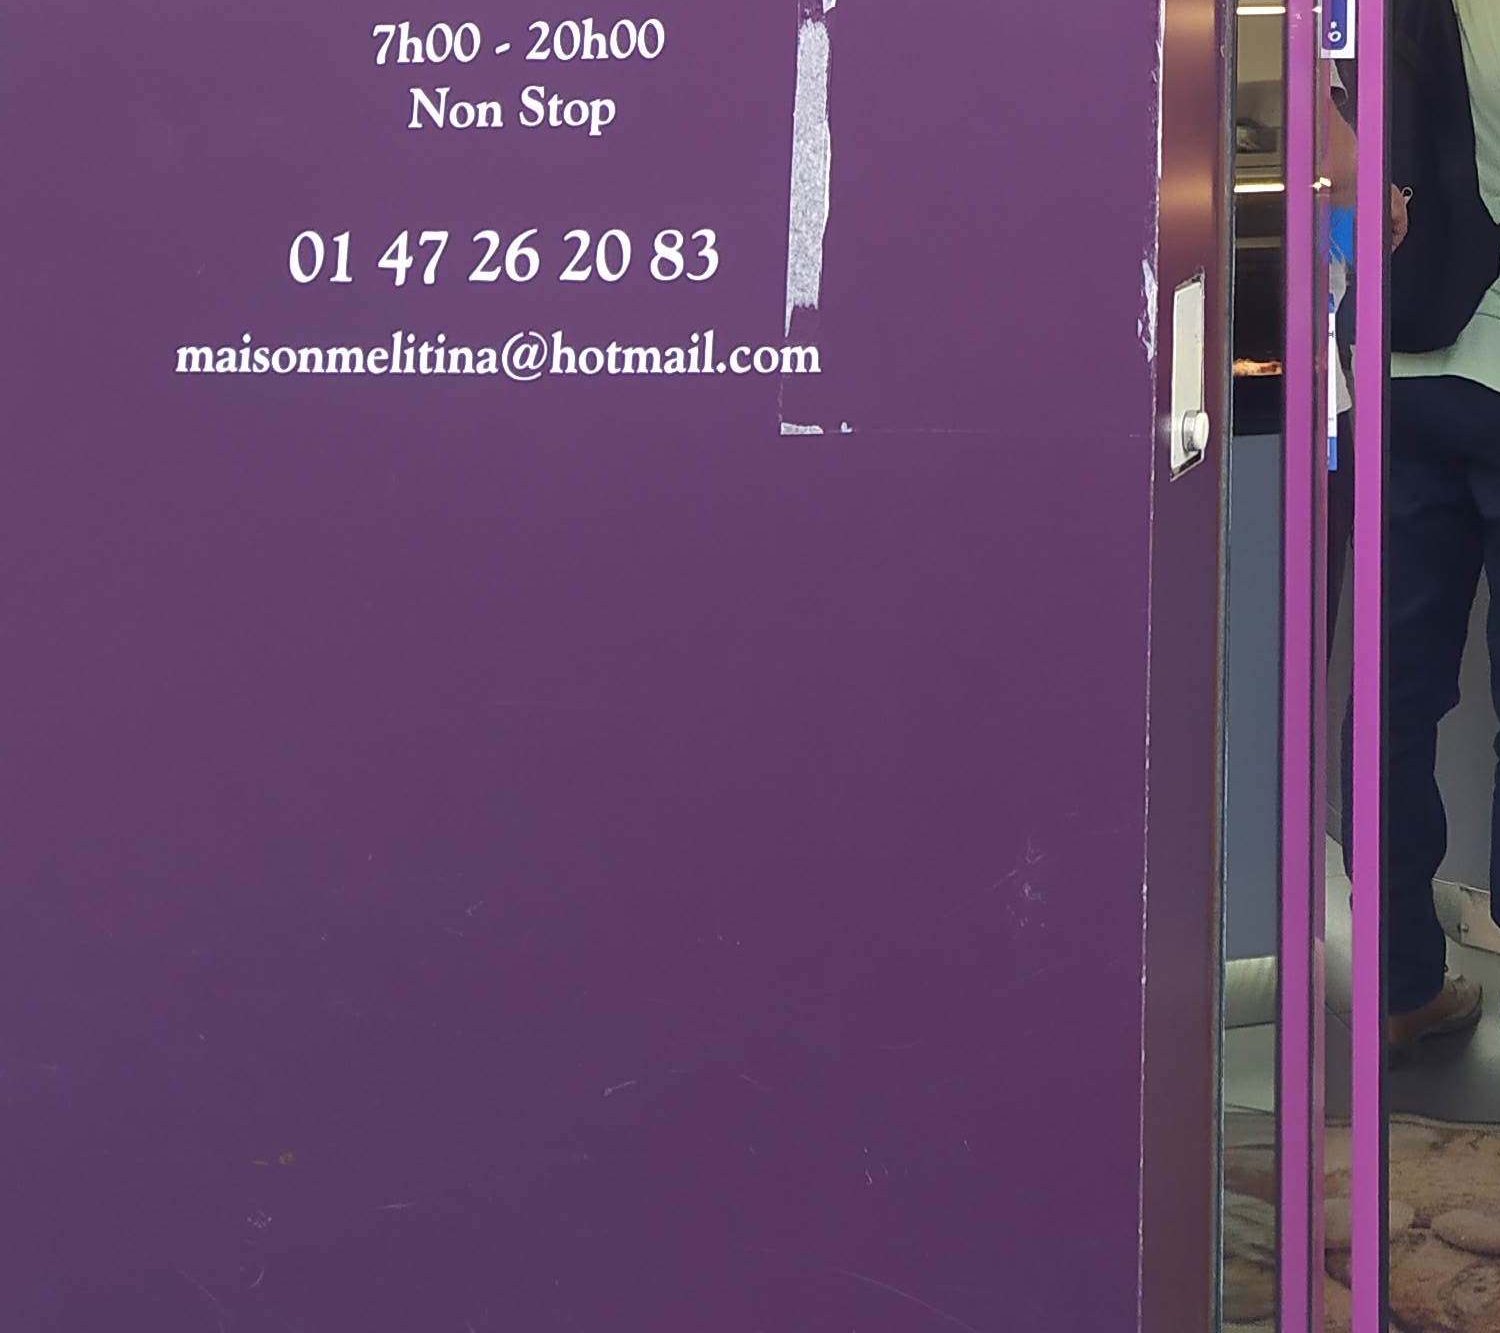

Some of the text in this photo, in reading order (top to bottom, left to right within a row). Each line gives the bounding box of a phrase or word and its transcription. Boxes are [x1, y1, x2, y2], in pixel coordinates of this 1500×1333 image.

[372, 17, 665, 65] 7h00 - 20h00
[408, 85, 616, 136] Non Stop
[289, 228, 720, 287] 01 47 26 20 83
[175, 330, 822, 381] maisonmelitina@hotmail.com
